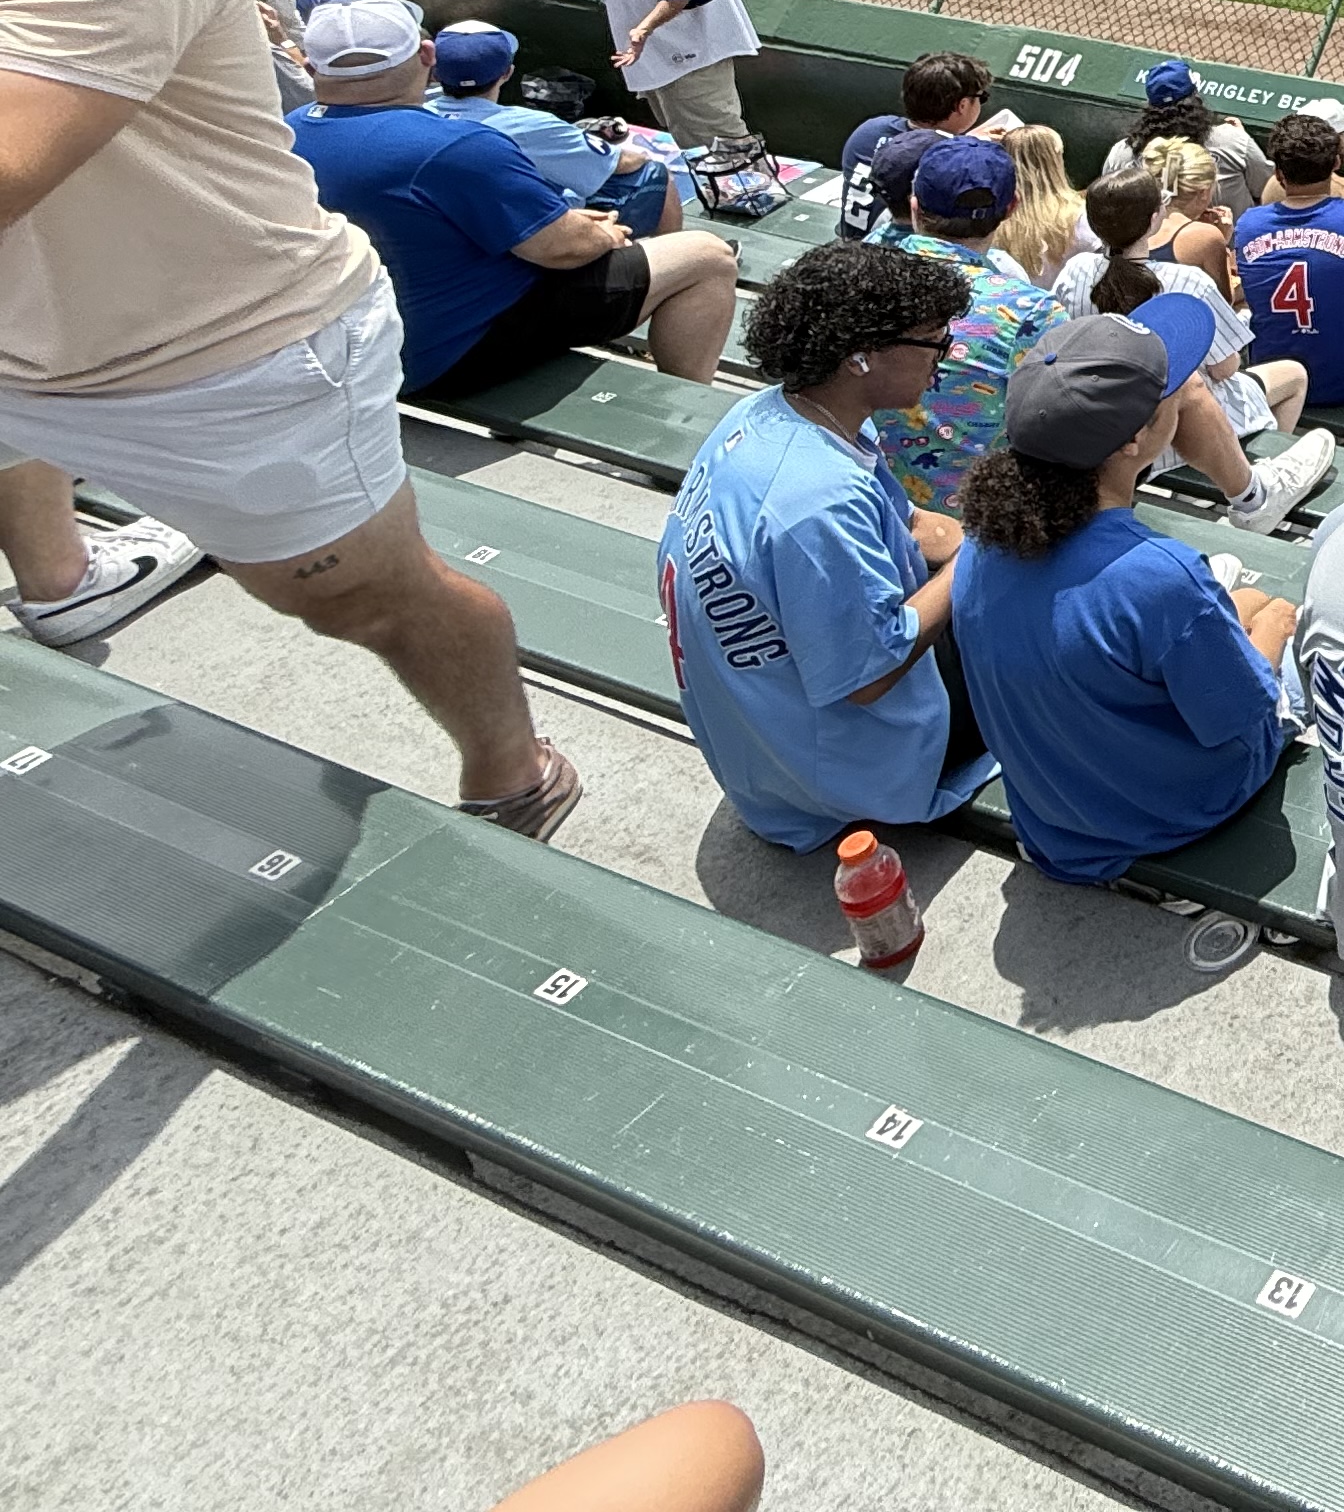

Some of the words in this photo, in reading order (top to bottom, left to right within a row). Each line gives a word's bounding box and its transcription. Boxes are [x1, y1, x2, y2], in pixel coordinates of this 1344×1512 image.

[1009, 44, 1083, 87] 504
[1270, 261, 1315, 329] 4
[7, 752, 43, 768] 17
[258, 854, 294, 876] 16
[543, 974, 580, 999] 15
[875, 1113, 914, 1140] 14
[1267, 1276, 1305, 1309] 13
